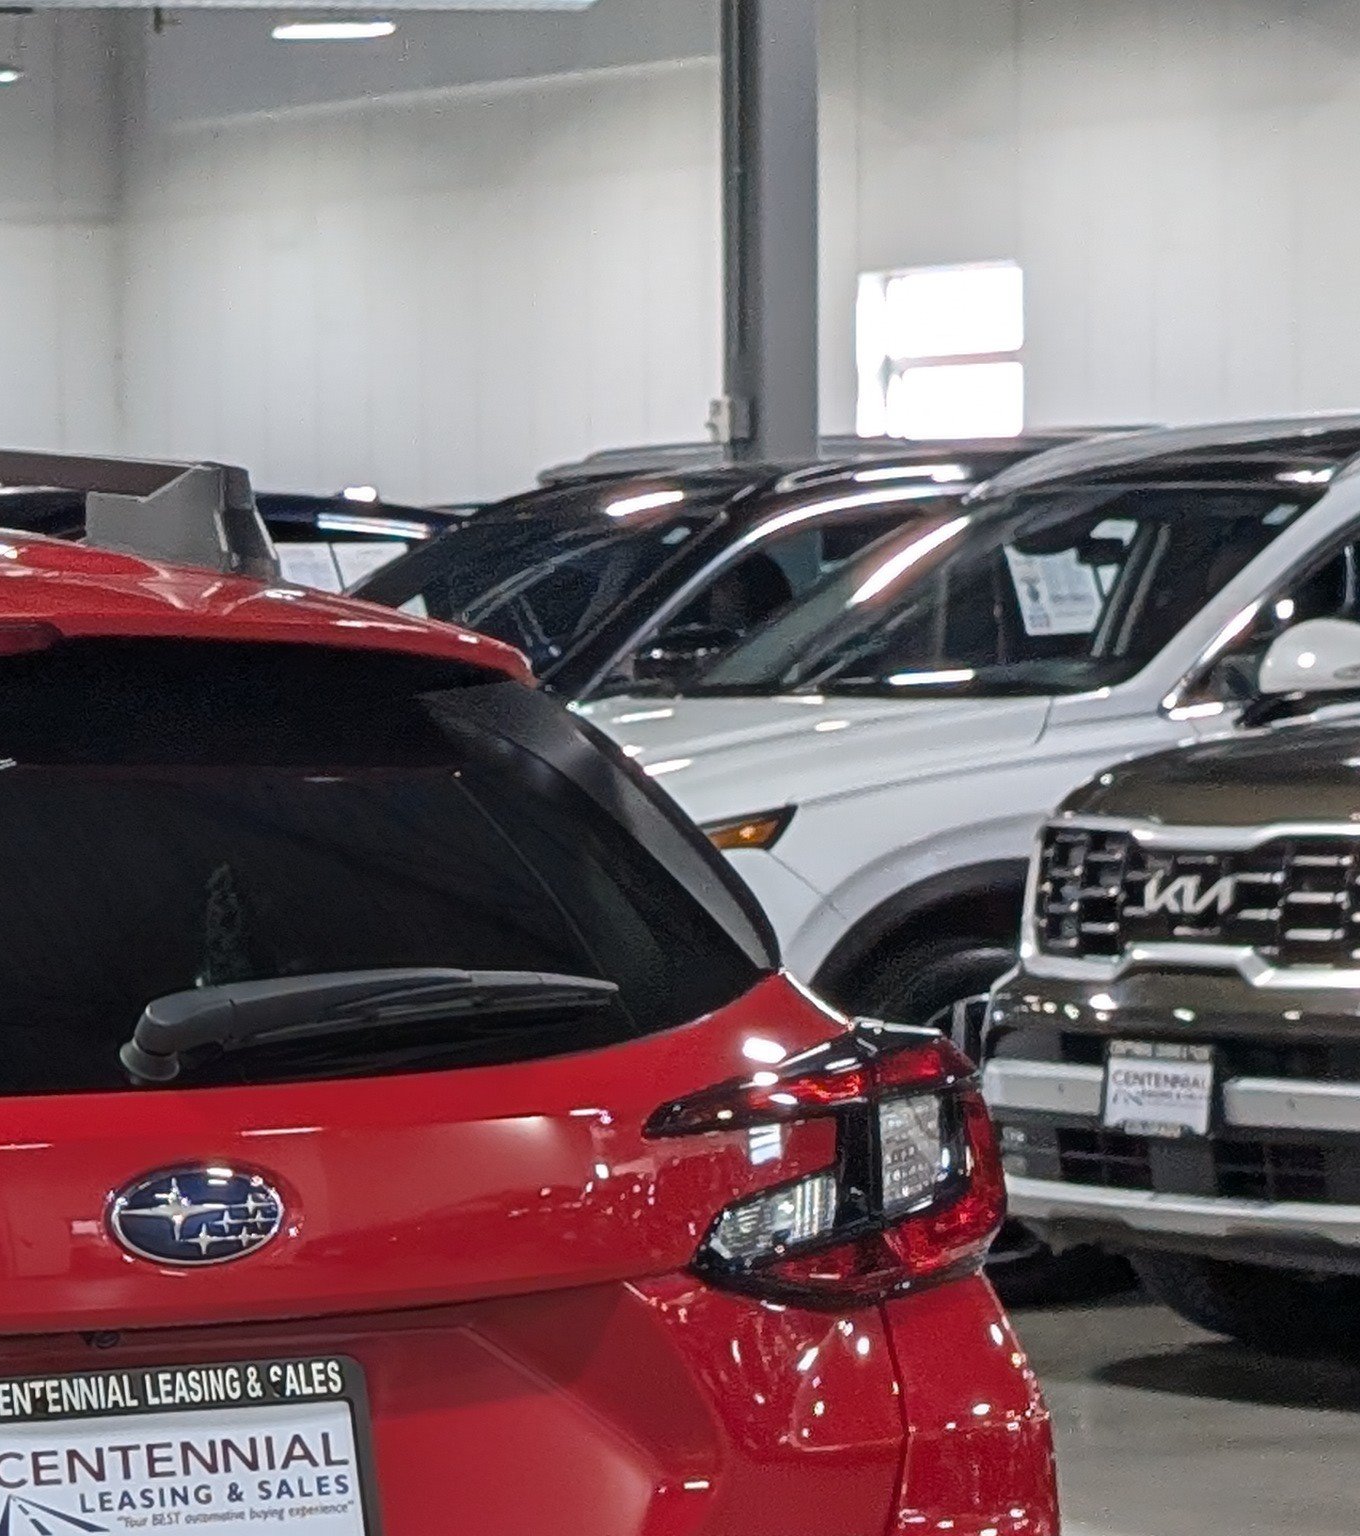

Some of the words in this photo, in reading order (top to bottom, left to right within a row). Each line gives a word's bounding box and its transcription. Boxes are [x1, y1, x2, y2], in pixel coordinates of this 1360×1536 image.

[1144, 868, 1237, 914] KIA
[144, 1366, 242, 1406] LEASING
[246, 1365, 264, 1399] &
[269, 1360, 343, 1399] SALES
[79, 1484, 214, 1514] LEASING
[226, 1481, 245, 1503] &
[257, 1473, 350, 1502] SALES
[152, 1511, 180, 1527] BEST
[249, 1506, 285, 1521] buying
